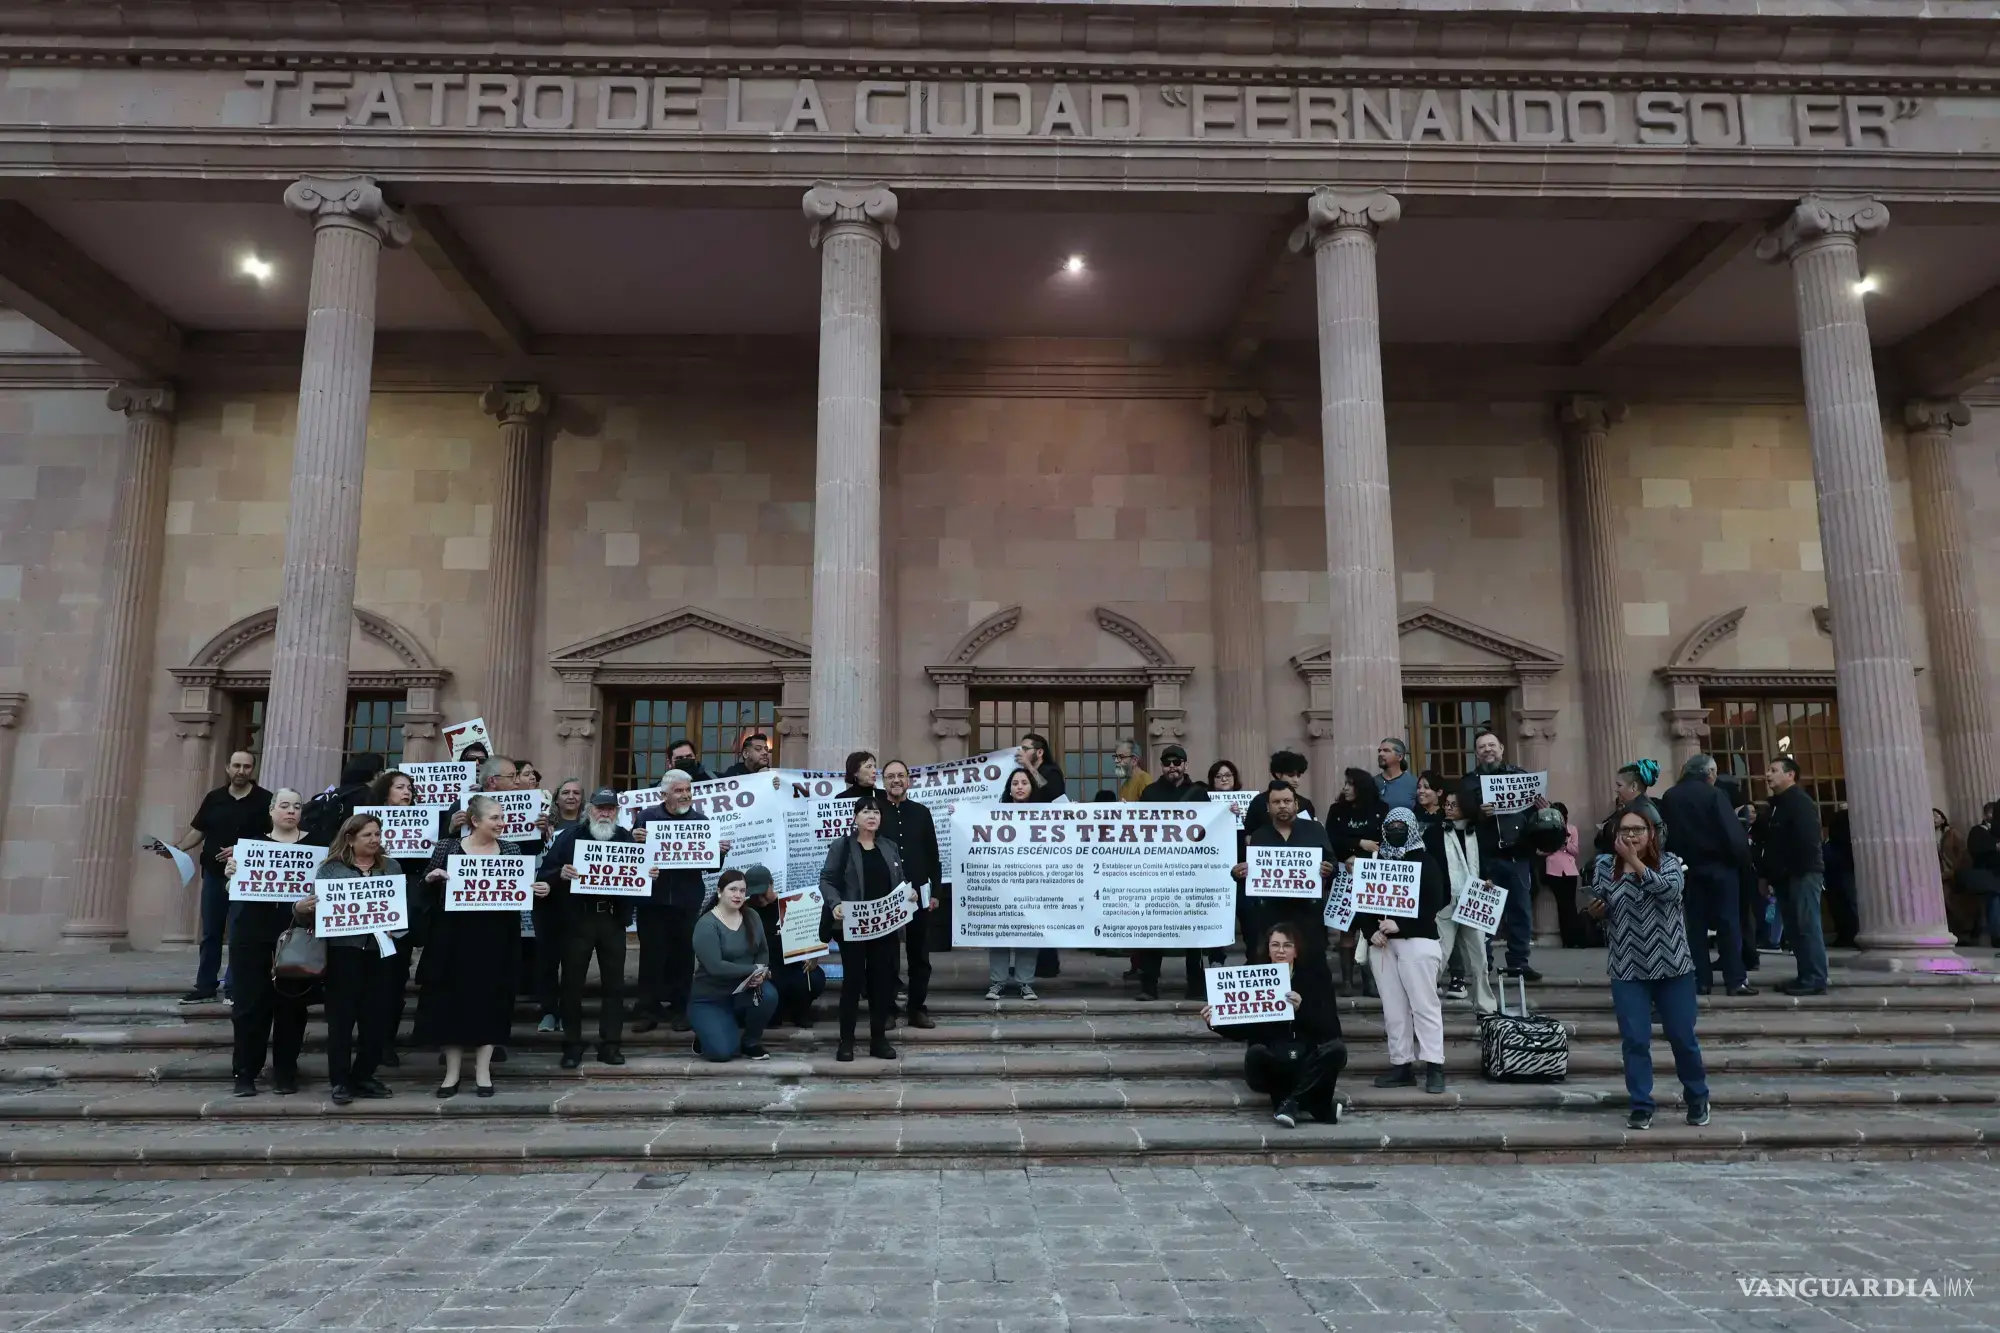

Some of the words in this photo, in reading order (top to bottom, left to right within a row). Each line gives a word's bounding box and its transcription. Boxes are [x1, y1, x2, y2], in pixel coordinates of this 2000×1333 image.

[245, 69, 574, 129] TEATRO
[598, 76, 702, 131] DE
[727, 78, 829, 132] LA
[855, 80, 1141, 138] CIUDAD
[427, 765, 465, 773] TEATRO
[925, 756, 988, 771] TEATRO
[910, 765, 1002, 789] EATRO
[415, 783, 438, 793] NO
[443, 783, 461, 792] ES
[692, 780, 739, 796] ATRO
[792, 781, 833, 798] NO
[1508, 782, 1540, 790] TEATRO
[921, 785, 989, 799] DEMANDAMOS:
[1495, 793, 1516, 801] NO
[1520, 789, 1536, 798] ES
[417, 793, 460, 803] EATR
[990, 810, 1013, 820] UN
[1017, 810, 1088, 820] TEATRO
[1093, 810, 1122, 820] SIN
[1127, 810, 1197, 820] TEATRO
[822, 820, 842, 828] NO
[402, 829, 422, 838] ES
[972, 824, 1017, 843] NO
[1029, 824, 1066, 843] ES
[1076, 824, 1206, 843] TEATRO
[384, 839, 431, 849] ATRO
[661, 842, 682, 851] NO
[688, 842, 705, 850] ES
[247, 850, 263, 858] UN
[269, 850, 313, 859] TEATRO
[606, 846, 644, 854] TEATRO
[968, 846, 1015, 855] ARTISTAS
[1017, 845, 1073, 855] ESCÉNICOS
[1075, 846, 1090, 855] DE
[1091, 846, 1141, 855] COAHUILA
[1144, 846, 1220, 855] DEMANDAMOS:
[607, 855, 645, 863] TEATRO
[654, 851, 714, 861] TEATRO
[270, 860, 313, 868] TEATRO
[461, 859, 476, 867] UN
[481, 859, 523, 867] TEATRO
[1093, 863, 1099, 874] 2
[1276, 859, 1312, 867] TEATRO
[1363, 862, 1376, 870] UN
[1380, 863, 1414, 872] TEATRO
[589, 864, 614, 874] NO
[619, 866, 638, 875] ES
[1260, 869, 1283, 878] NO
[1288, 870, 1307, 878] ES
[250, 870, 277, 880] NO
[284, 871, 305, 881] ES
[579, 875, 645, 887] TEATRO
[1361, 872, 1377, 880] SIN
[1380, 873, 1414, 883] TEATRO
[238, 881, 313, 893] TEATRO
[328, 883, 344, 891] UN
[348, 880, 393, 890] TEATRO
[464, 880, 490, 889] NO
[496, 880, 516, 889] ES
[1252, 879, 1316, 889] TEATRO
[1365, 883, 1387, 894] NO
[1392, 884, 1409, 896] ES
[1471, 881, 1480, 889] UN
[326, 892, 345, 901] SIN
[350, 890, 395, 900] TEATRO
[453, 891, 526, 901] TEATRO
[1325, 905, 1333, 915] UN
[1331, 872, 1341, 901] TEATRO
[1330, 905, 1338, 918] SIN
[1336, 871, 1347, 902] TEATRO
[1468, 889, 1478, 898] SIN
[1478, 892, 1500, 905] TEATRO
[871, 891, 903, 909] TEATRO
[1356, 894, 1415, 909] TEATRO
[333, 903, 360, 915] NO
[367, 901, 389, 912] ES
[873, 897, 904, 915] TEATRO
[1337, 898, 1348, 916] NO
[1466, 898, 1480, 909] NO
[1482, 904, 1494, 914] ES
[322, 912, 400, 927] TEATRO
[858, 918, 881, 927] NO
[886, 906, 901, 919] ES
[1458, 906, 1496, 926] TEATRO
[849, 911, 908, 935] TEATRO
[1094, 925, 1100, 936] 6
[1218, 972, 1233, 980] UN
[1237, 968, 1278, 978] TEATRO
[1217, 981, 1234, 989] SIN
[1238, 978, 1281, 988] TEATRO
[1224, 992, 1250, 1003] NO
[1255, 989, 1276, 1000] ES
[1216, 1001, 1287, 1016] TEATRO
